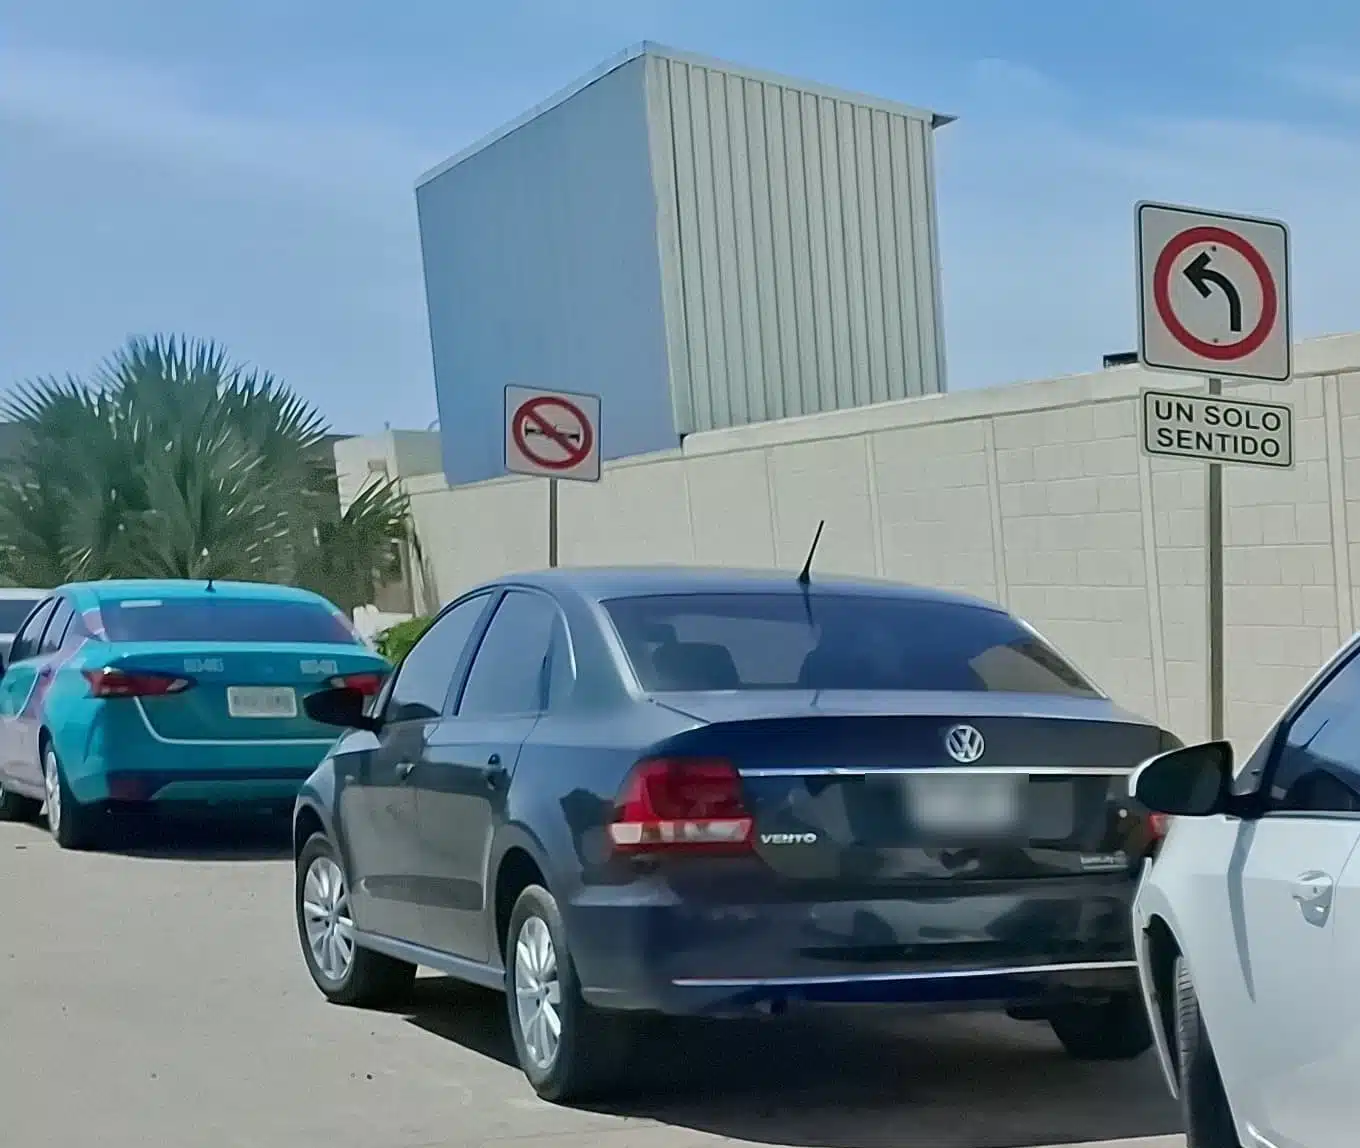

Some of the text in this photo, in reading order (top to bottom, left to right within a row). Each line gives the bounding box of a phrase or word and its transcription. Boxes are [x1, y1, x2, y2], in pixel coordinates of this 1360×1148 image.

[1155, 400, 1282, 431] UN SOLO
[1157, 428, 1280, 458] SENTIDO
[760, 832, 817, 845] VENTO
